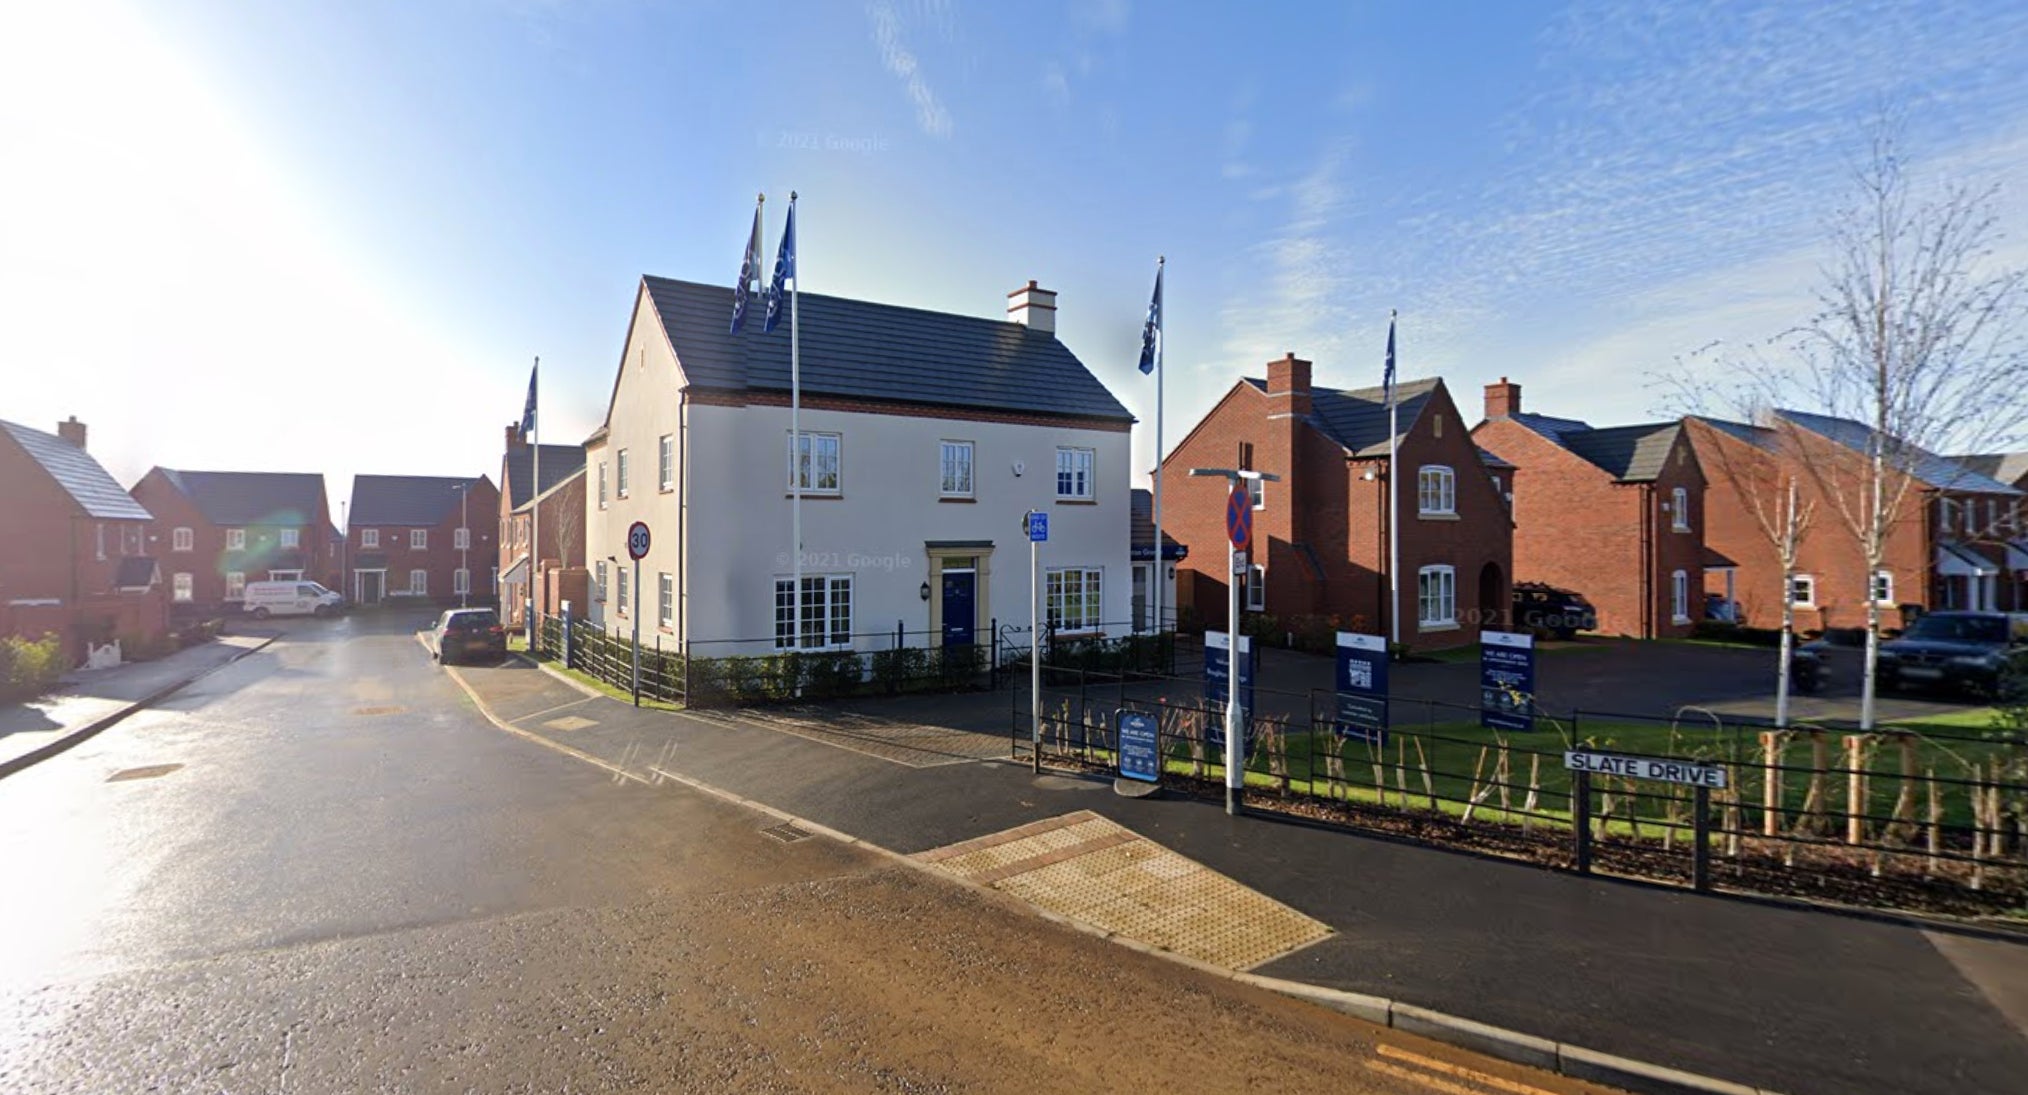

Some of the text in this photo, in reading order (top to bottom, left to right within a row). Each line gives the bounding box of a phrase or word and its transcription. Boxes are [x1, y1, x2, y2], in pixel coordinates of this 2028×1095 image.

[632, 533, 648, 548] 30
[1571, 753, 1719, 786] SLATE DRIVE
